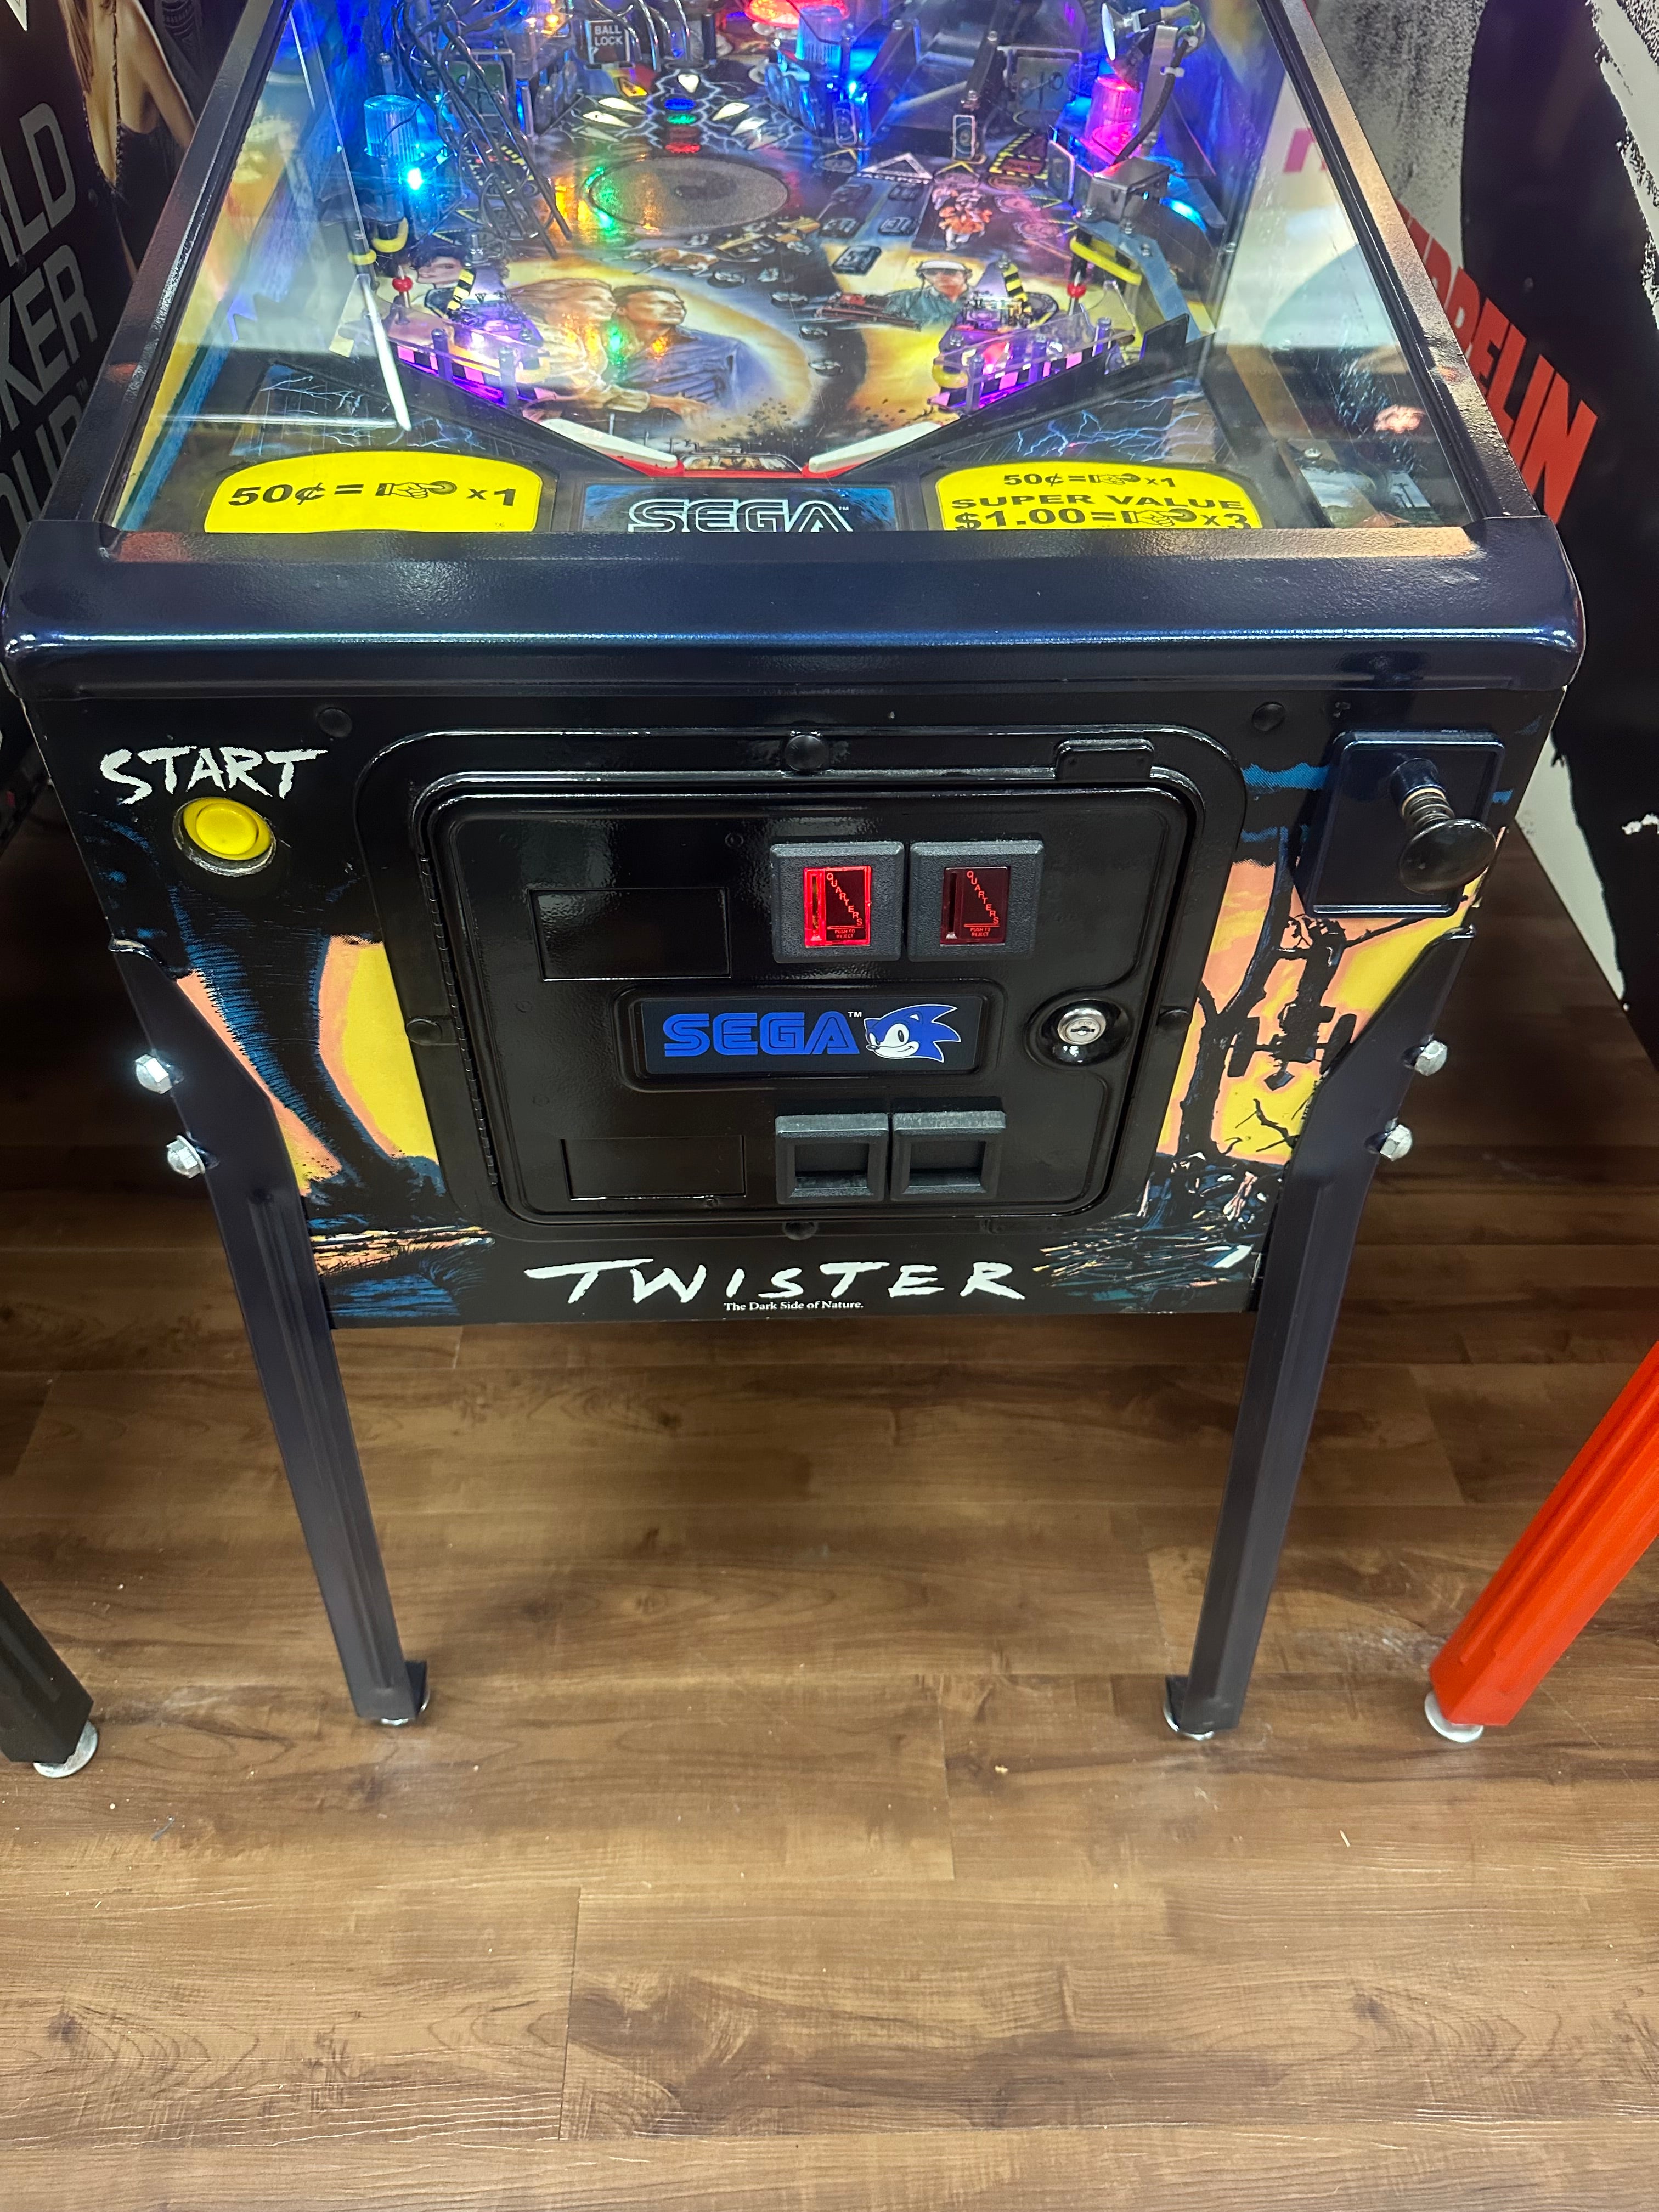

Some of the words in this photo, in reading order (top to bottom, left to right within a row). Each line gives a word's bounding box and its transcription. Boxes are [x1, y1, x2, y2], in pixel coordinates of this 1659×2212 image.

[594, 25, 622, 35] BALL
[594, 35, 624, 46] LOCK
[951, 494, 1096, 510] SUPER
[1106, 495, 1245, 511] VALUE
[100, 746, 329, 805] START
[826, 872, 863, 926] QUARTERS
[967, 870, 1000, 924] QUARTERS
[524, 1258, 1026, 1304] TWISTER
[724, 1302, 746, 1311] The
[749, 1302, 777, 1311] Dark
[780, 1301, 804, 1310] Side
[806, 1301, 821, 1310] of
[821, 1300, 864, 1310] Nature.
